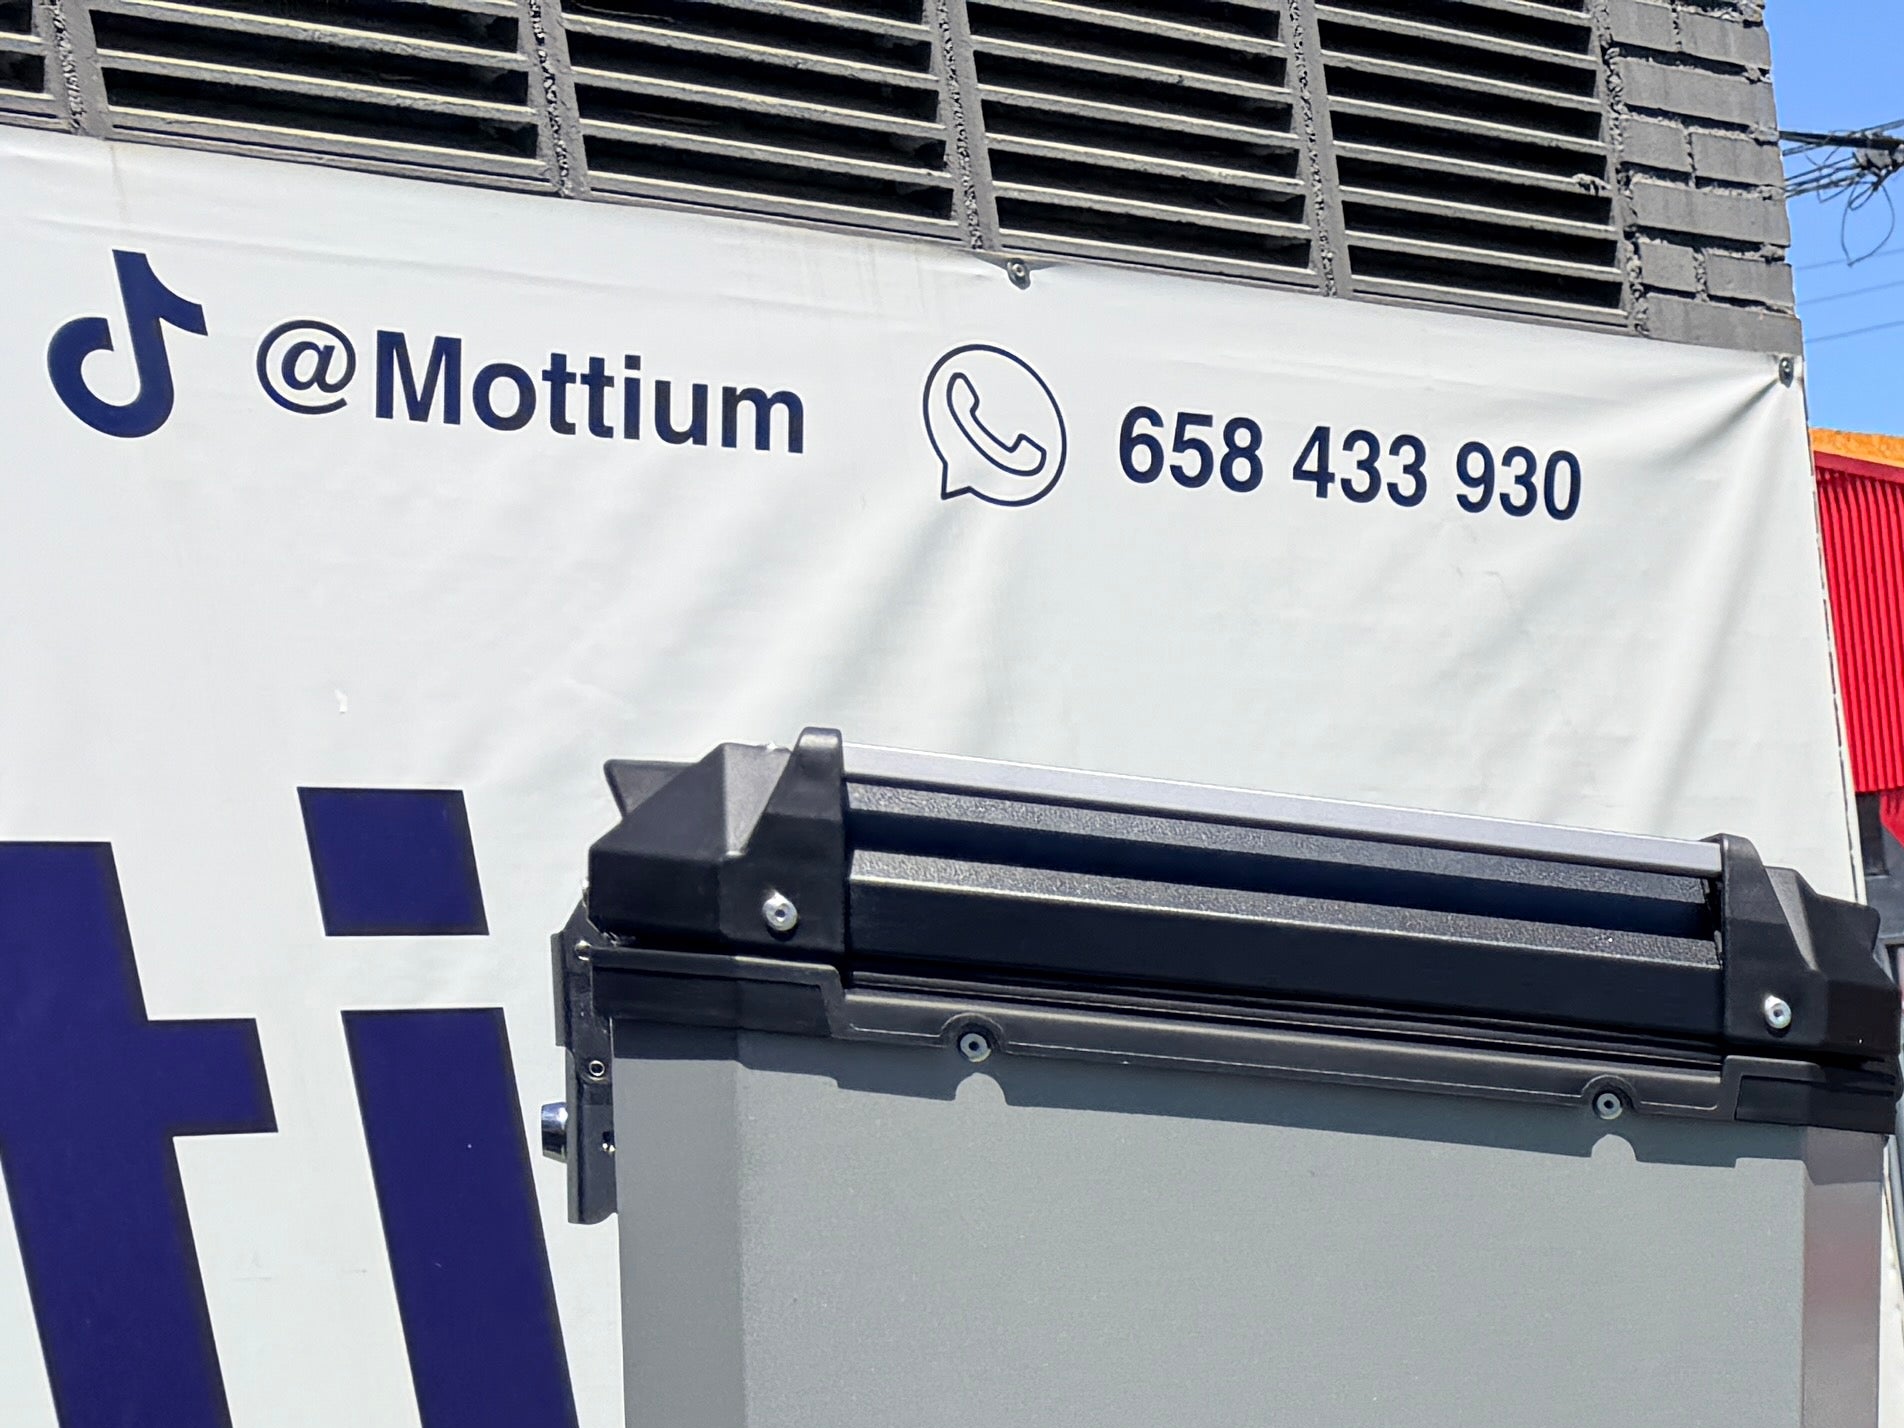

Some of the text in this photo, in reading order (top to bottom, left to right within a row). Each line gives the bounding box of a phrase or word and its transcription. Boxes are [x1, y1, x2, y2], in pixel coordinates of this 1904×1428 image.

[256, 319, 804, 453] @Mottium
[1119, 406, 1582, 521] 658 433 930
